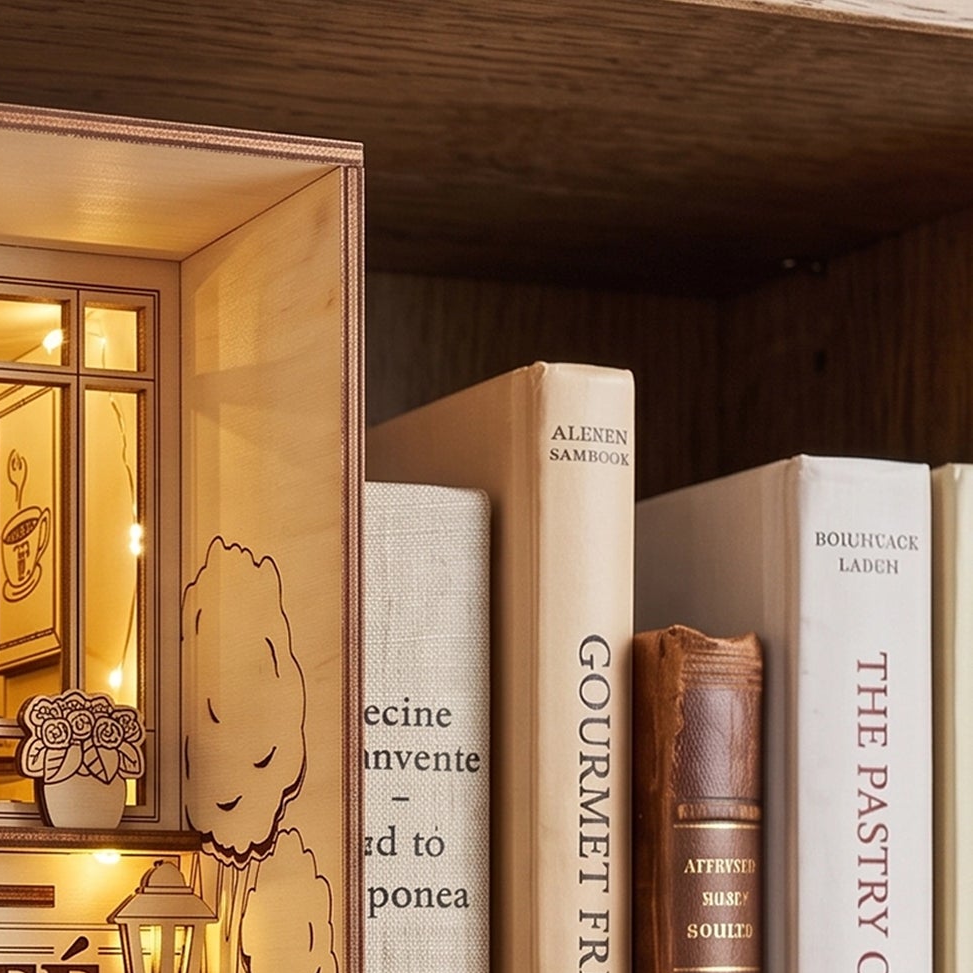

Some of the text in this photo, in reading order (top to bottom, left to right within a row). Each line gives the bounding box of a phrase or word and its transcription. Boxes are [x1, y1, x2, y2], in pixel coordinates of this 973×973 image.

[548, 447, 630, 467] SAMBOOK
[578, 634, 611, 893] GOURMET
[857, 651, 889, 748] THE
[857, 765, 889, 937] PASTRY
